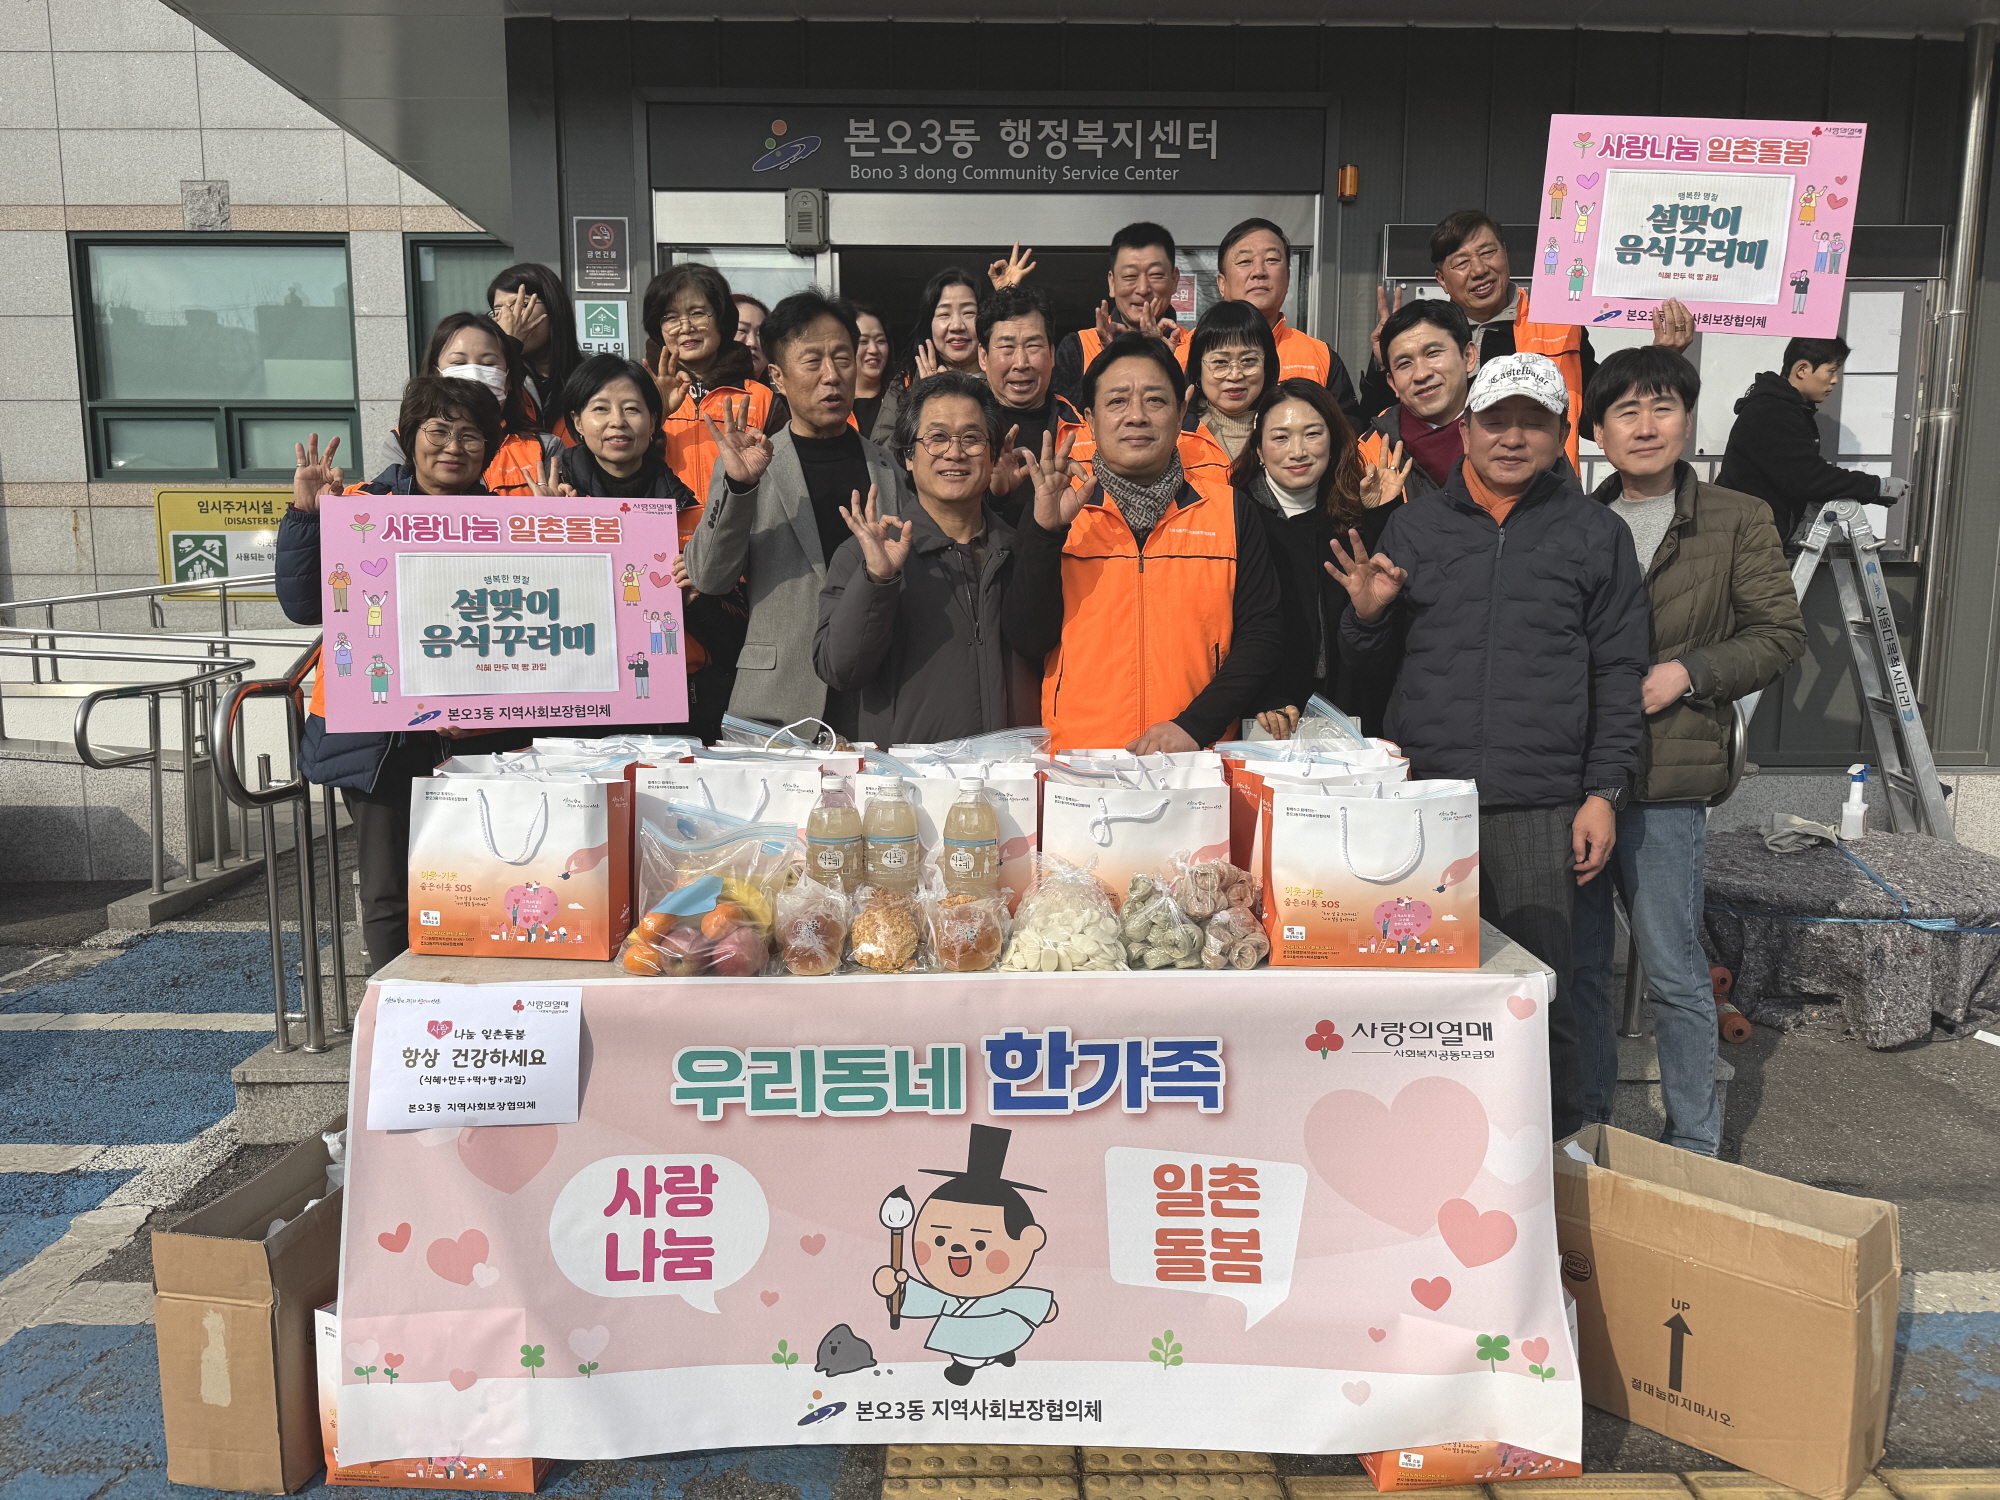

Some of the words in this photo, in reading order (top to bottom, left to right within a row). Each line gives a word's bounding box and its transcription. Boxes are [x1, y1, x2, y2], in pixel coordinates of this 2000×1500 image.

[844, 118, 981, 159] 본오3동
[999, 118, 1218, 160] 행정복지센터
[1598, 133, 1700, 162] 사랑나눔
[1706, 137, 1810, 166] 일촌돌봄
[850, 165, 893, 180] Bono
[898, 165, 908, 180] 3
[914, 164, 957, 183] dong
[962, 164, 1058, 183] Community
[1062, 165, 1119, 180] Service
[1124, 165, 1180, 180] Center
[1678, 191, 1701, 200] 행복한
[1703, 192, 1719, 202] 명절
[1646, 203, 1743, 235] 설맞이
[1614, 234, 1769, 270] 음식꾸러미
[1658, 271, 1672, 279] 식혜
[1673, 272, 1687, 280] 만두
[1693, 312, 1768, 328] 사회보장협의체
[197, 500, 274, 515] 임시주거시설
[224, 517, 268, 526] (DISASTER
[381, 515, 500, 543] 사랑나눔
[508, 516, 622, 544] 일촌돌봄
[235, 553, 265, 562] 사용되는
[483, 574, 509, 585] 행복한
[512, 574, 530, 586] 명절
[451, 587, 560, 622] 설맞이
[419, 622, 596, 658] 음식꾸러미
[1875, 605, 1911, 708] 서울다목적사다리
[476, 663, 492, 672] 식혜
[493, 664, 509, 672] 만두
[531, 662, 547, 671] 과일
[447, 705, 495, 721] 본오3동
[499, 703, 611, 720] 지역사회보장협의체
[454, 883, 472, 893] SOS
[1321, 900, 1340, 909] SOS
[430, 1024, 449, 1036] 사랑
[454, 1028, 476, 1040] 나눔
[481, 1028, 526, 1041] 일촌돌봄
[1351, 1021, 1494, 1047] 사랑의열매
[402, 1047, 441, 1069] 항상
[451, 1048, 547, 1069] 건강하세요
[1393, 1049, 1495, 1061] 사회복지공동모금회
[673, 1045, 968, 1118] 우리동네
[982, 1028, 1224, 1114] 한가족
[408, 1103, 442, 1113] 본오3동
[447, 1100, 536, 1113] 지역사회보장협의체
[603, 1164, 719, 1219] 사랑
[1152, 1162, 1262, 1219] 일촌
[604, 1229, 715, 1284] 나눔
[1152, 1227, 1264, 1285] 돌봄
[1671, 1297, 1691, 1312] UP
[855, 1399, 926, 1423] 본오3동
[931, 1398, 1103, 1423] 지역사회보장협의체
